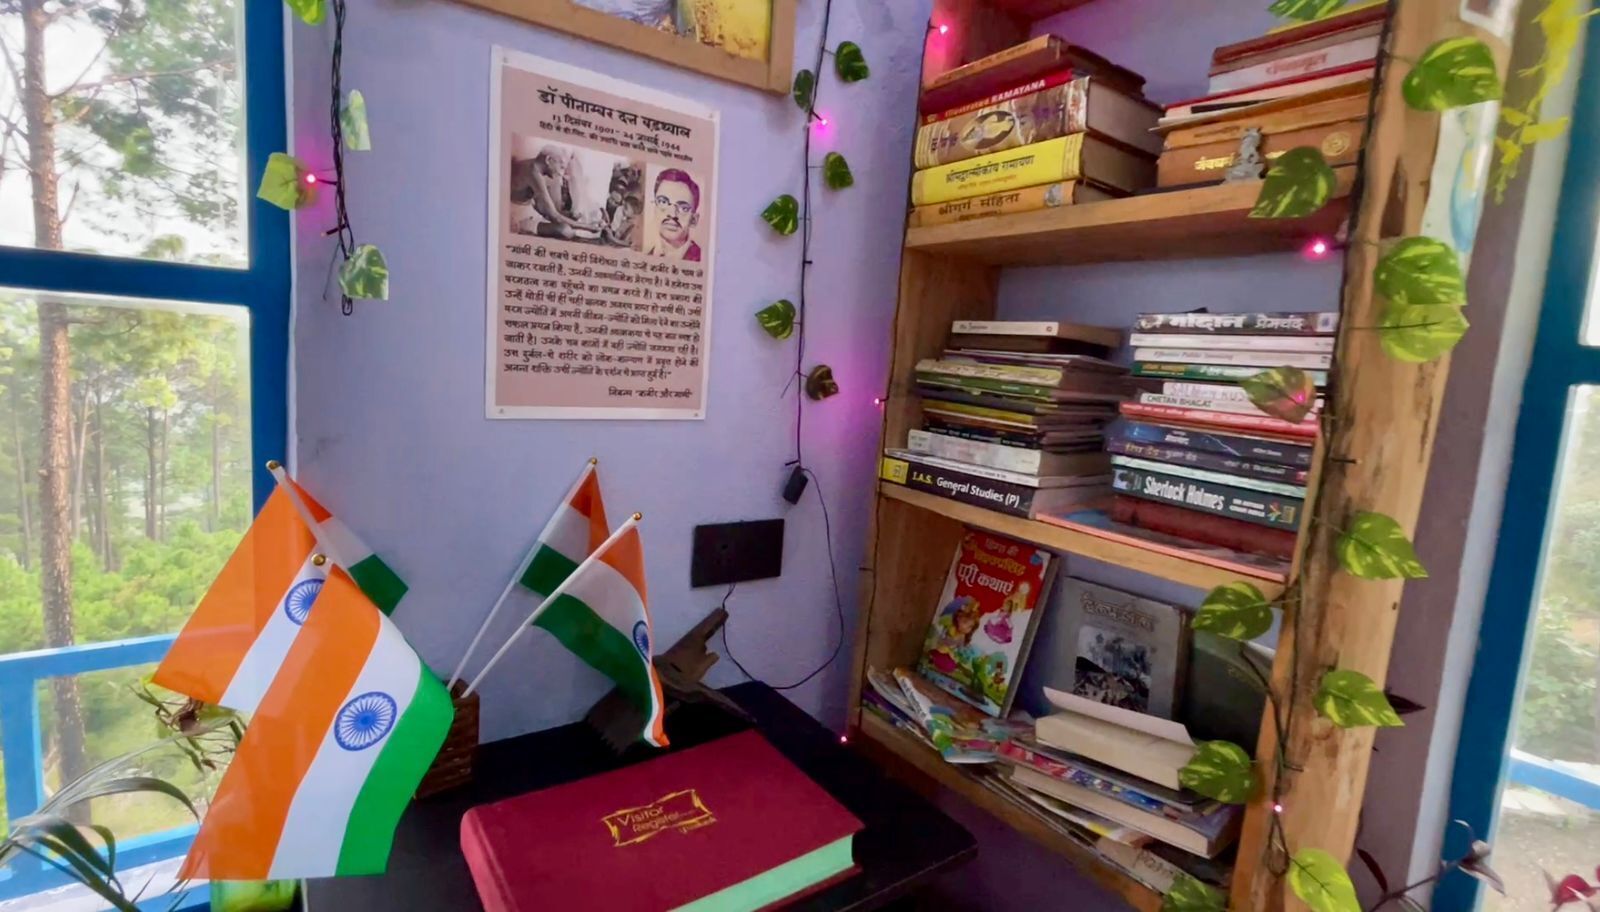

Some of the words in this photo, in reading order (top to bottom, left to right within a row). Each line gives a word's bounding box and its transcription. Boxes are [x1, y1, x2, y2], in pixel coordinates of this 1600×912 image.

[536, 85, 557, 105] डॉ
[558, 92, 616, 119] पीताम्बर
[990, 79, 1046, 103] RAMAYANA
[936, 476, 970, 494] General
[970, 485, 1005, 502] Studies
[1005, 492, 1021, 508] (P)
[1143, 475, 1187, 502] Sherlock
[1186, 484, 1225, 511] Holmes
[957, 562, 980, 588] परी
[616, 805, 664, 827] Visitor
